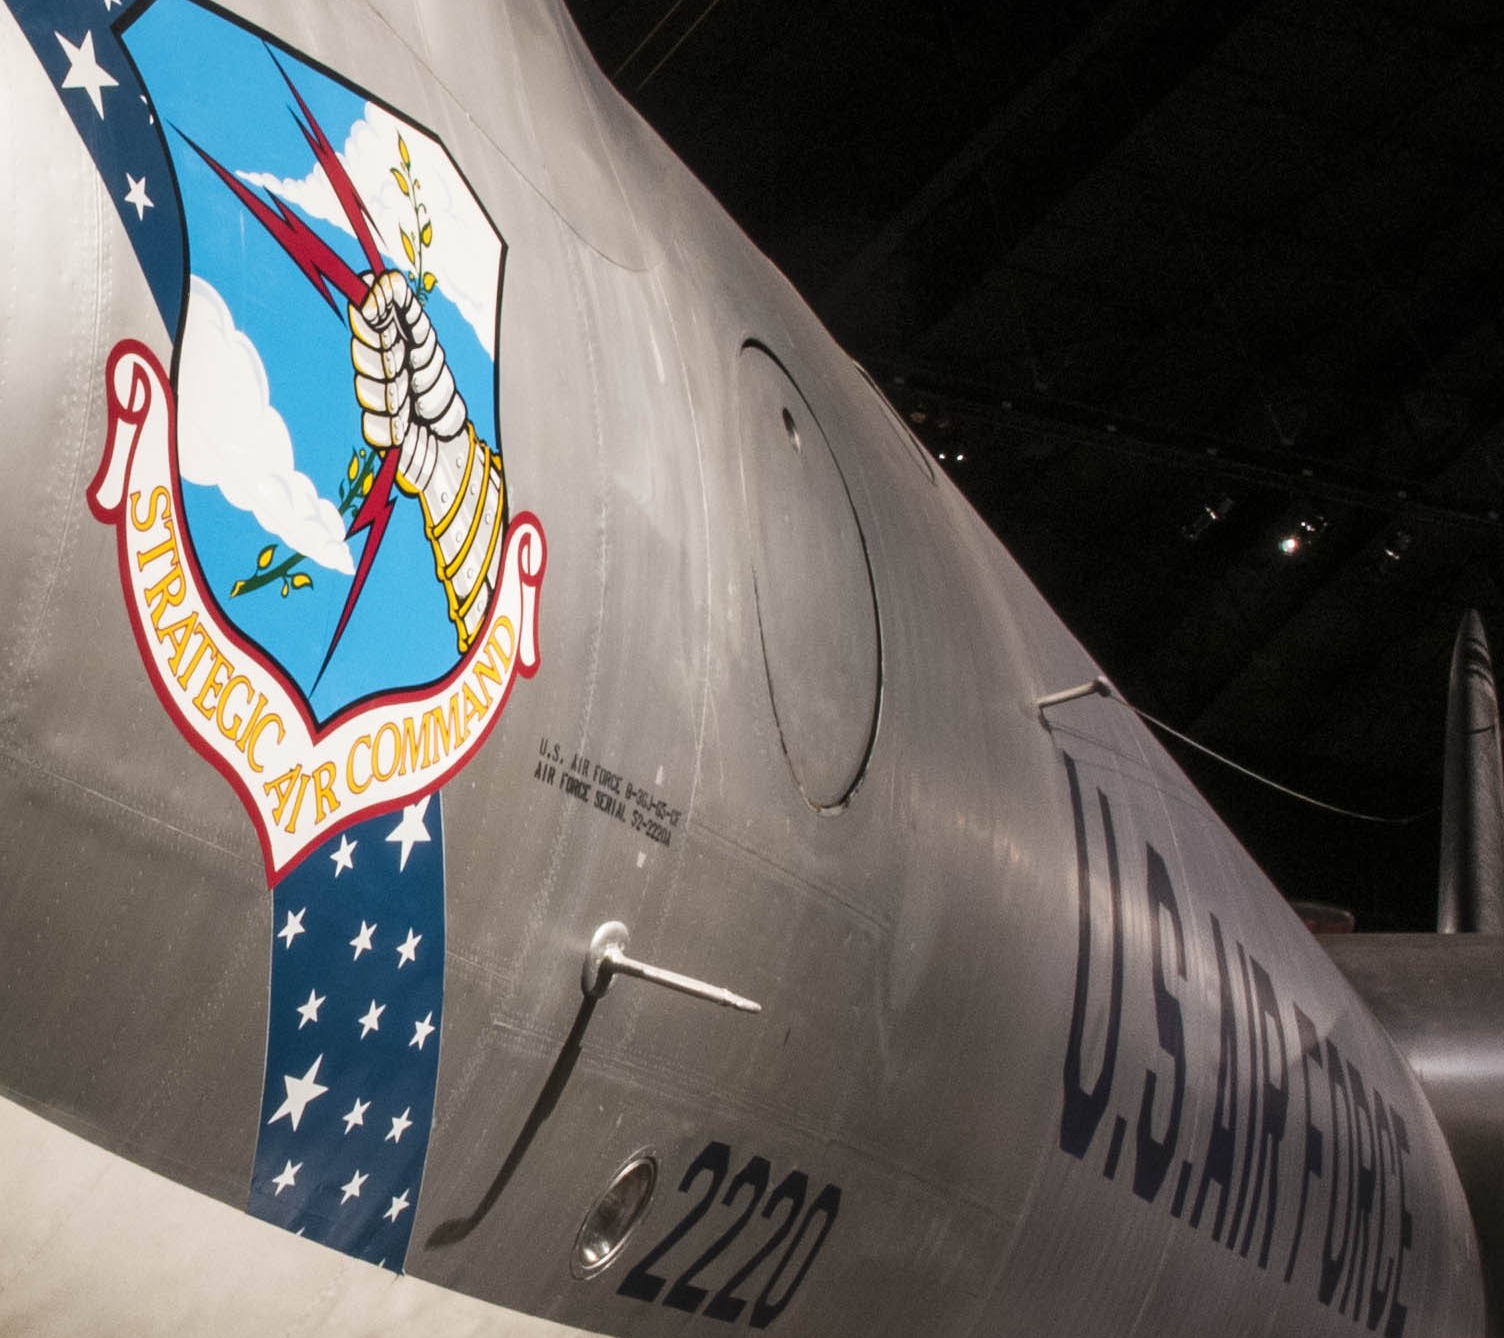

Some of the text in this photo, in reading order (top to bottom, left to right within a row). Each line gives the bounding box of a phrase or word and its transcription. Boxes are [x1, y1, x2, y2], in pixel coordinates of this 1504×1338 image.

[129, 485, 286, 774] STRATEGIC
[264, 615, 516, 835] AIR COMMAND
[534, 760, 556, 786] AIR
[559, 772, 592, 803] FORCE
[539, 737, 564, 765] U.S.
[570, 753, 591, 778] AIR
[593, 764, 623, 796] FORCE
[615, 1141, 842, 1330] 2220
